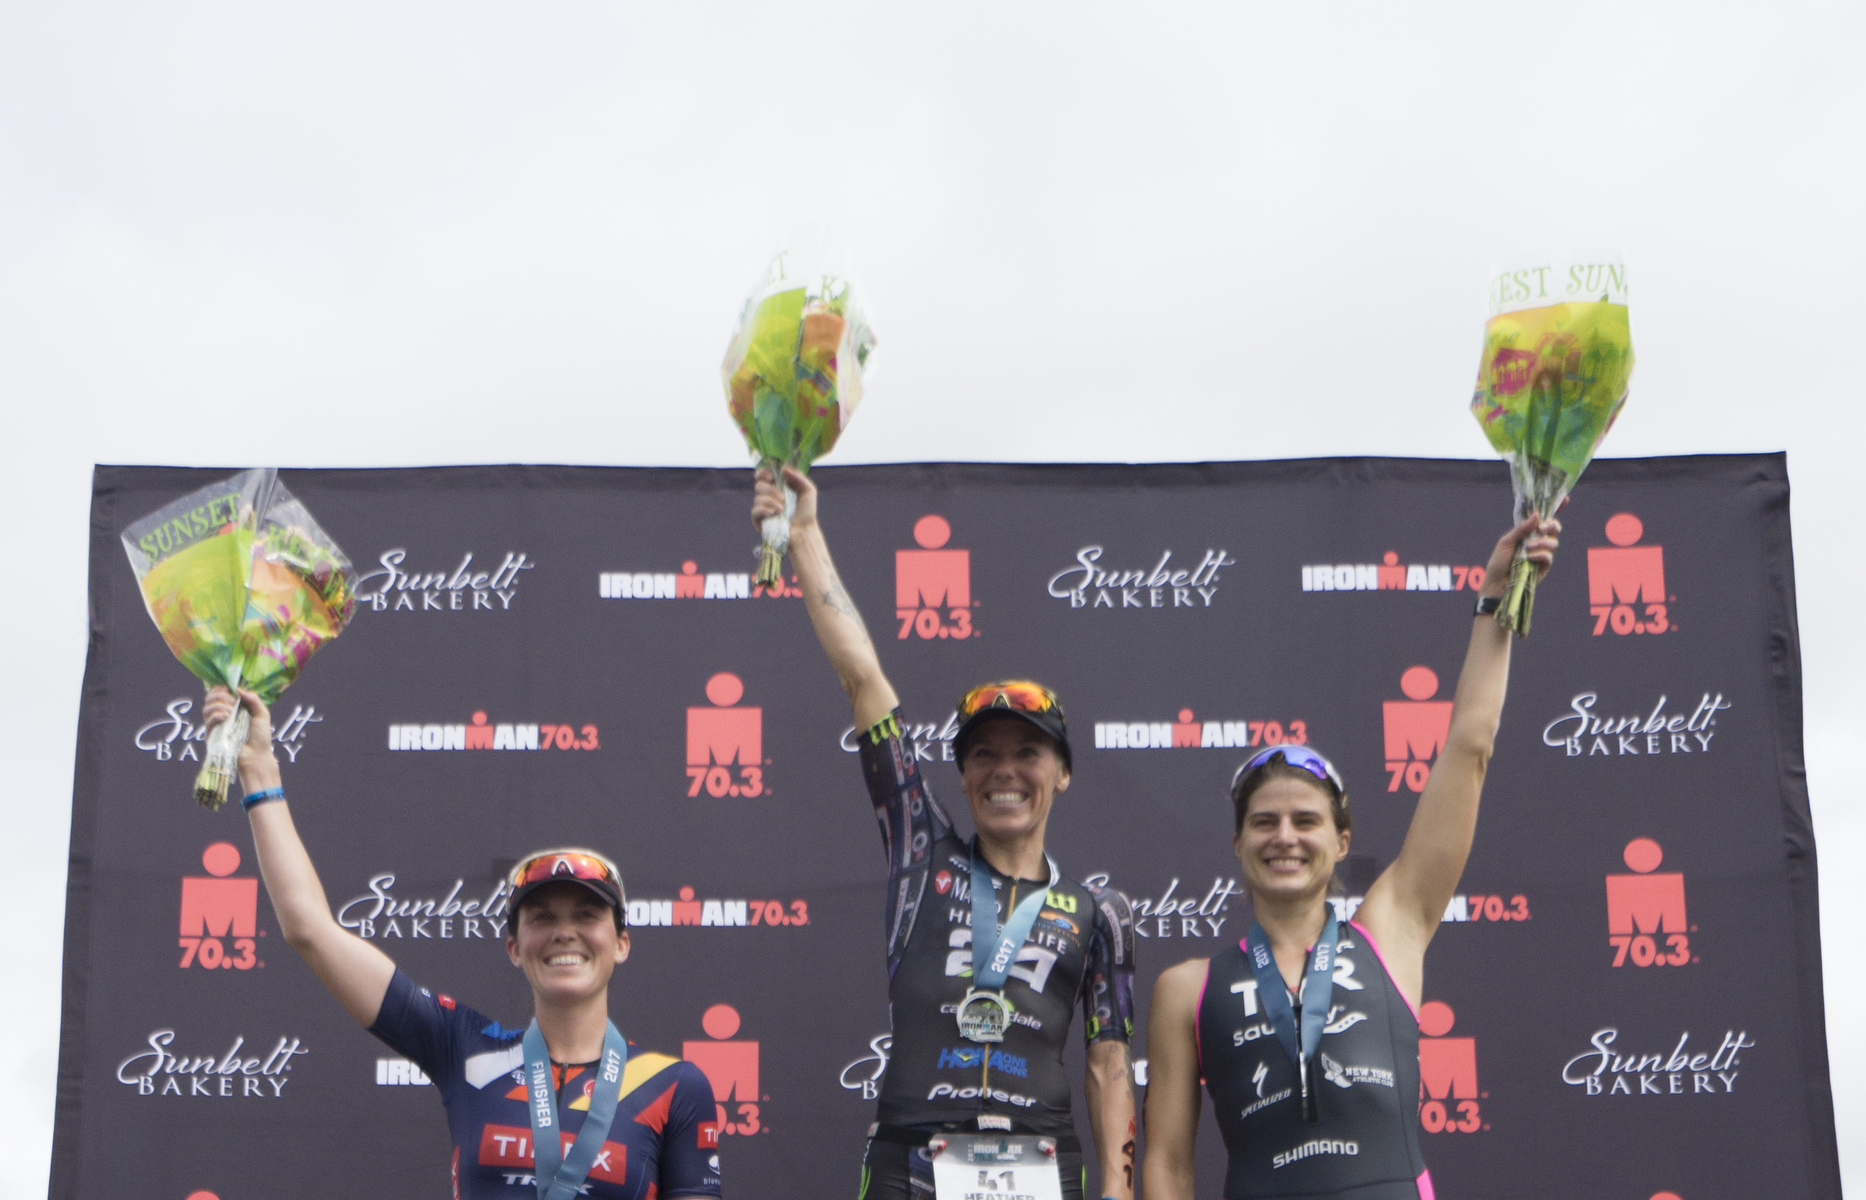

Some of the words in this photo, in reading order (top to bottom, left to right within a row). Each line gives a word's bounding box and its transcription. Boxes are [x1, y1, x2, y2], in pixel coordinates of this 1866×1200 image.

[1566, 264, 1628, 294] SUN
[139, 493, 240, 562] SUNSET
[354, 549, 535, 601] Sunbelt
[600, 560, 749, 599] IRONMAN
[1049, 545, 1236, 598] Sunbelt
[1302, 551, 1451, 591] IRONMAN
[373, 591, 516, 611] BAKERY
[1070, 588, 1218, 608] BAKERY
[896, 608, 972, 640] 70.3
[1590, 604, 1668, 635] 70.3
[389, 711, 539, 750] IRONMAN
[540, 724, 598, 750] 70.3
[1095, 708, 1247, 748] IRONMAN
[1249, 720, 1308, 747] 70.3
[1543, 693, 1732, 748] Sunbelt
[1566, 734, 1716, 757] BAKERY
[686, 767, 763, 798] 70.3
[338, 875, 508, 929] Sunbel
[750, 901, 809, 926] 70.3
[1469, 895, 1529, 922] 70.3
[178, 938, 256, 970] 70.3
[991, 938, 1016, 973] 2017
[1314, 944, 1330, 972] 2017
[1609, 934, 1690, 968] 70.3
[116, 1031, 309, 1085] Sunbelt
[604, 1050, 622, 1083] 2017
[937, 1047, 1003, 1071] HOKA
[1563, 1028, 1756, 1085] Sunbelt
[138, 1076, 289, 1097] BAKERY
[531, 1060, 552, 1129] FINISHER
[927, 1083, 1037, 1107] Pioneer
[1586, 1073, 1739, 1096] BAKERY
[1420, 1100, 1482, 1135] 0.3
[1273, 1140, 1360, 1169] SHIMANO
[977, 1170, 1017, 1192] 41
